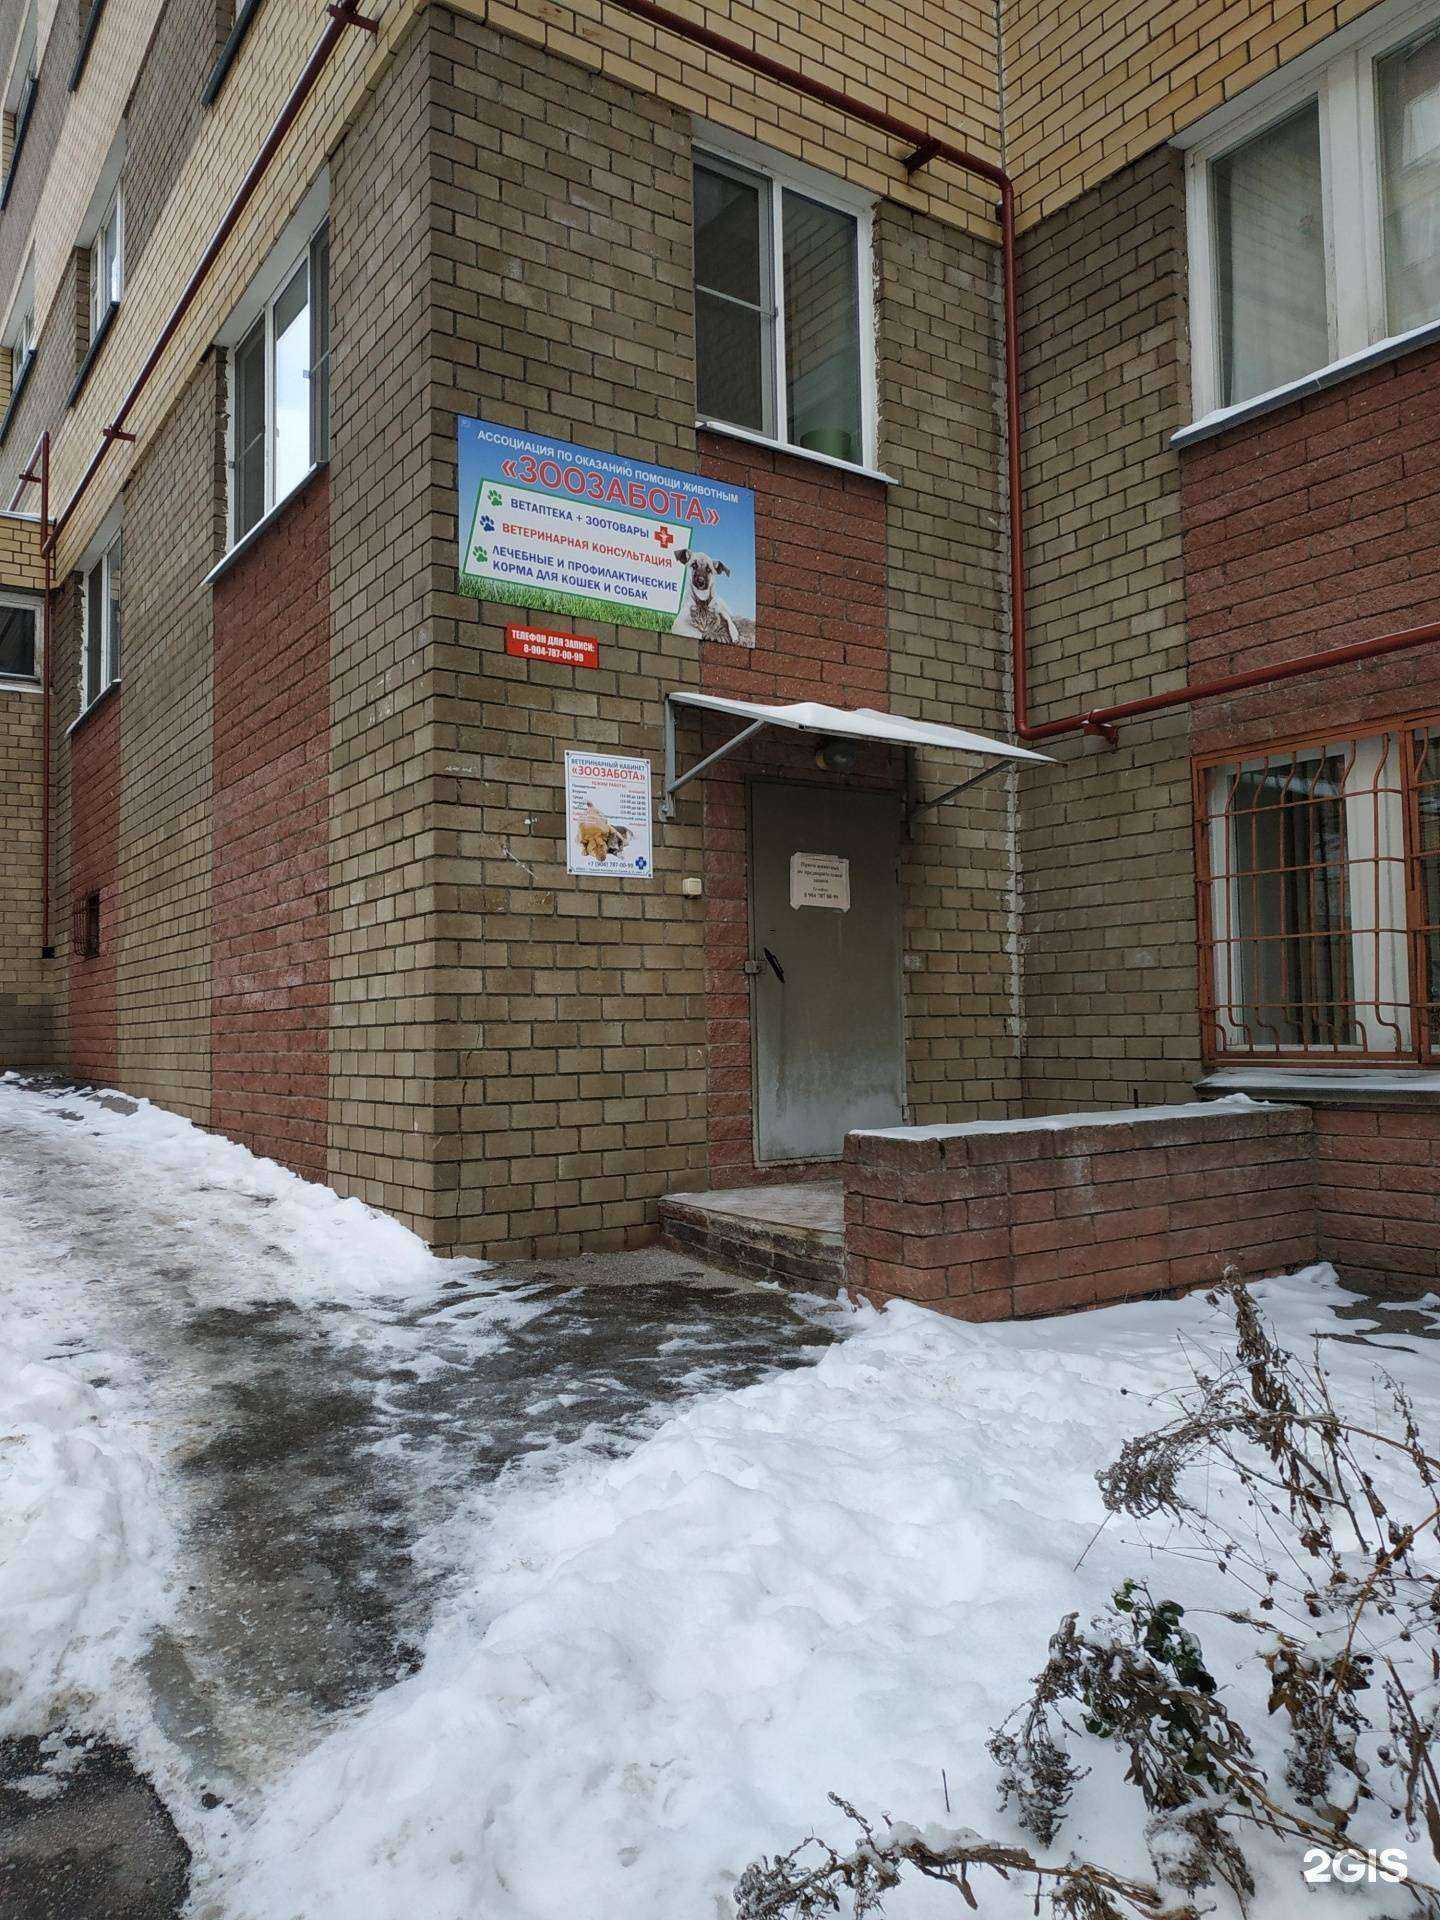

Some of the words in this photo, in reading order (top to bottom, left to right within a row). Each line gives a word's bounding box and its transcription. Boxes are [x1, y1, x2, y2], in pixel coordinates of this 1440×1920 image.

[477, 430, 555, 458] АССОЦИАЦИЯ
[557, 449, 573, 462] ПО
[575, 453, 633, 476] ОКАЗАНИЮ
[634, 469, 681, 490] ПОМОЩИ
[683, 480, 739, 504] ЖИВОТНЫМ
[501, 455, 720, 526] «ЗООЗАБОТА»
[510, 498, 573, 522] ВЕТАПТЕКА
[586, 514, 650, 539] ЗООТОВАРЫ
[502, 522, 589, 550] ВЕТЕРИНАРНАЯ
[592, 541, 673, 569] КОНСУЛЬТАЦИЯ
[492, 545, 555, 568] ЛЕЧЕБНЫЕ
[557, 558, 565, 569] И
[568, 560, 678, 593] ПРОФИЛАКТИЧЕСКИЕ
[493, 560, 534, 579] КОРМА
[535, 568, 559, 584] ДЛЯ
[561, 573, 601, 592] КОШЕК
[603, 581, 611, 593] И
[614, 583, 648, 601] СОБАК
[512, 629, 547, 644] ТЕЛЕФОН
[547, 635, 564, 647] ДЛЯ
[564, 638, 595, 652] ЗАПИСИ:
[571, 758, 619, 769] ВЕТЕРИНАРНЫЙ
[619, 763, 645, 772] КАБИНЕТ
[571, 766, 646, 781] «ЗООЗАБОТА»
